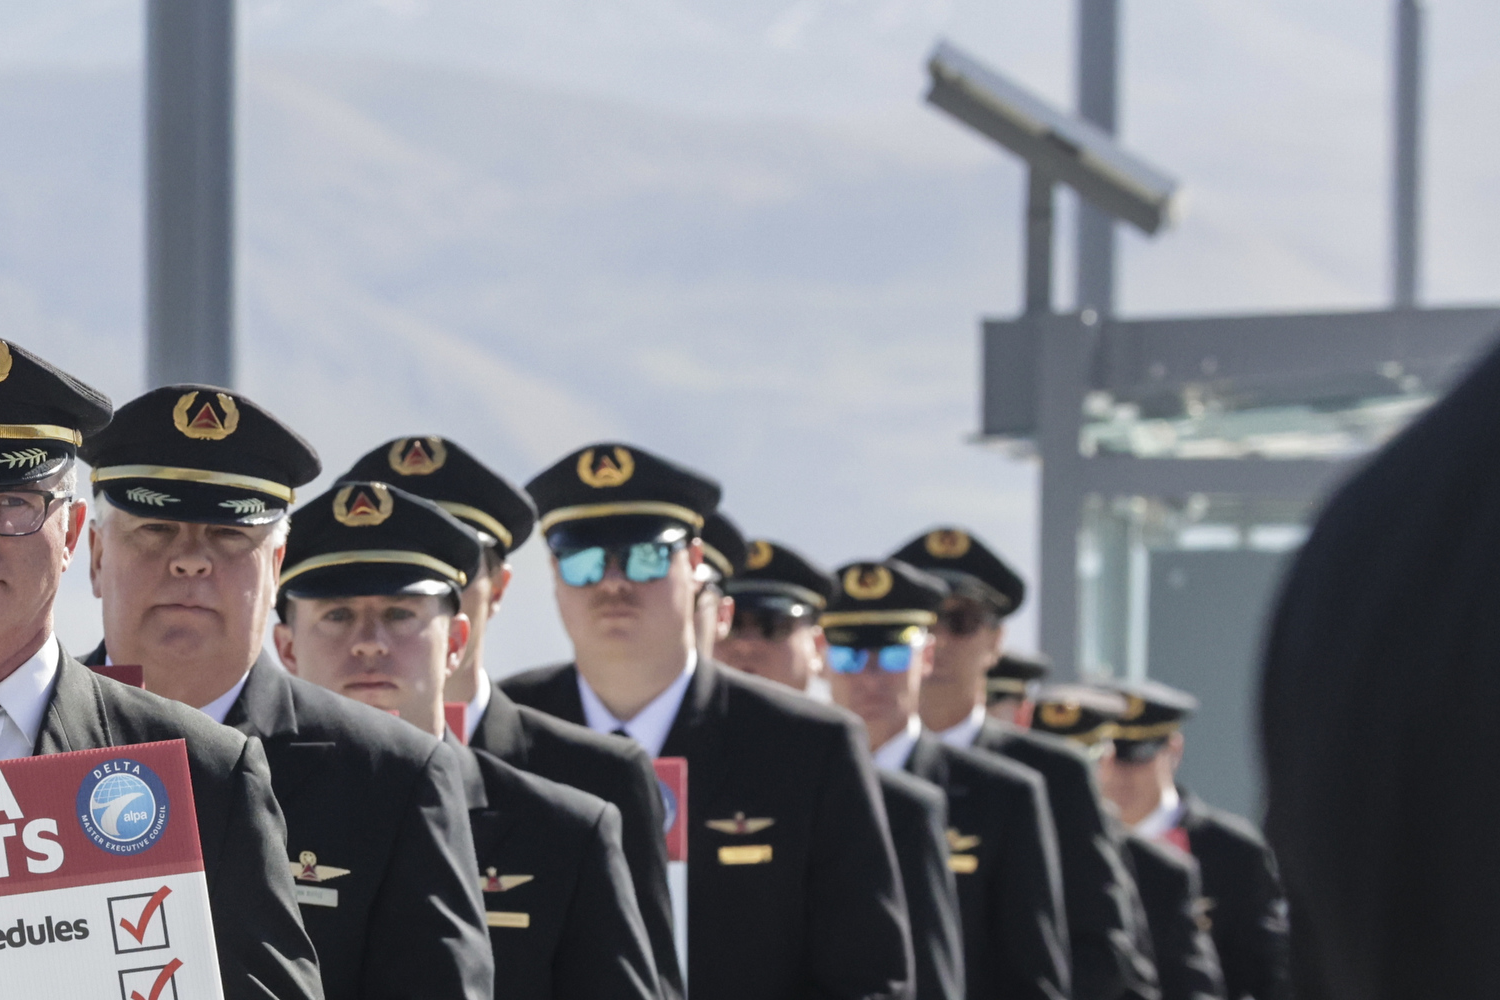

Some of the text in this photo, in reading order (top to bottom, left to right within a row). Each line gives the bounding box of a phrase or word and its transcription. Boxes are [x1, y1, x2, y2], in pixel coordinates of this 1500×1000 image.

[93, 761, 141, 779] DELTA
[123, 810, 148, 823] alpa
[81, 805, 166, 852] MASTER EXECUTIVE COUNCIL
